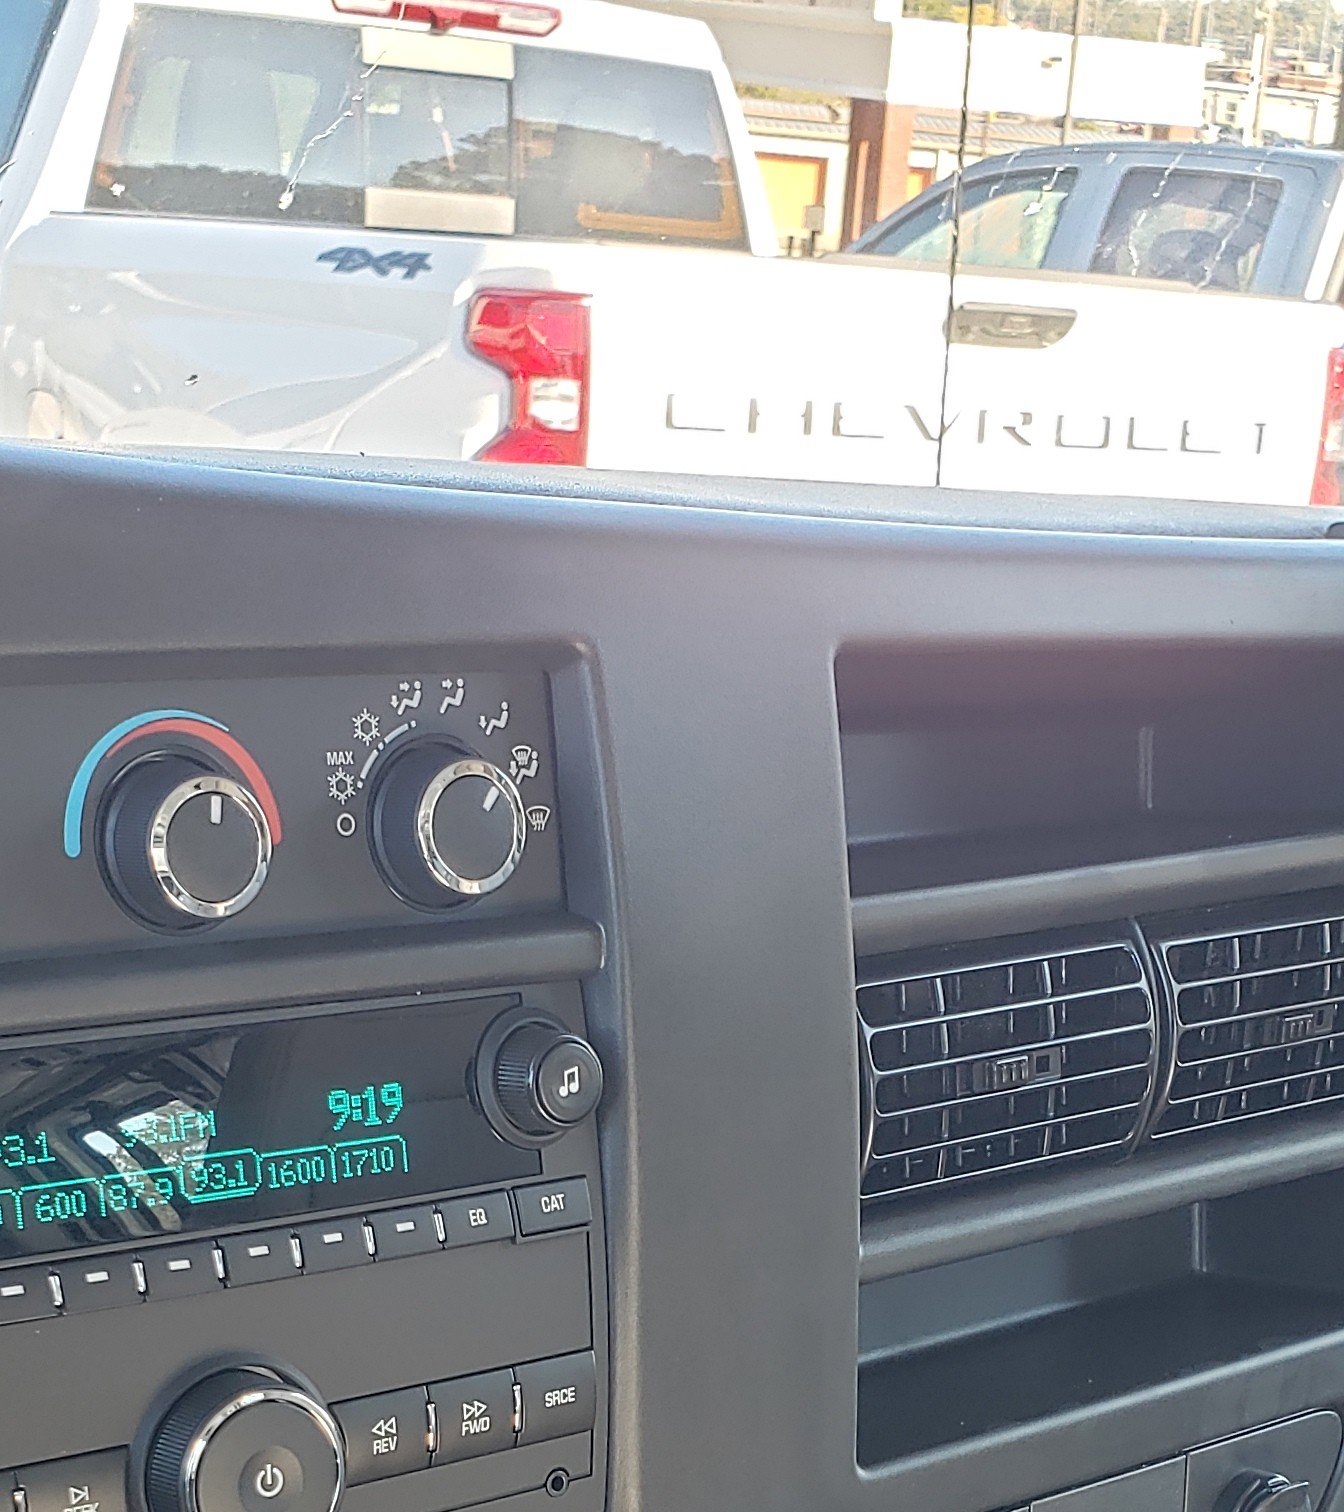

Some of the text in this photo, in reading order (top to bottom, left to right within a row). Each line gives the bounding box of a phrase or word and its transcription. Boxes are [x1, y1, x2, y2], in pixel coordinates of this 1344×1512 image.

[326, 750, 354, 766] MAX
[328, 1082, 404, 1131] 9:19
[34, 1189, 87, 1222] 600
[108, 1177, 174, 1211] 87.9
[190, 1159, 249, 1193] 93.1
[267, 1155, 326, 1189] 1600
[341, 1146, 395, 1178] 1710
[540, 1193, 565, 1213] CAT
[468, 1208, 488, 1227] EQ
[544, 1386, 576, 1408] SRCE
[461, 1416, 491, 1437] FWD
[373, 1436, 398, 1455] REV
